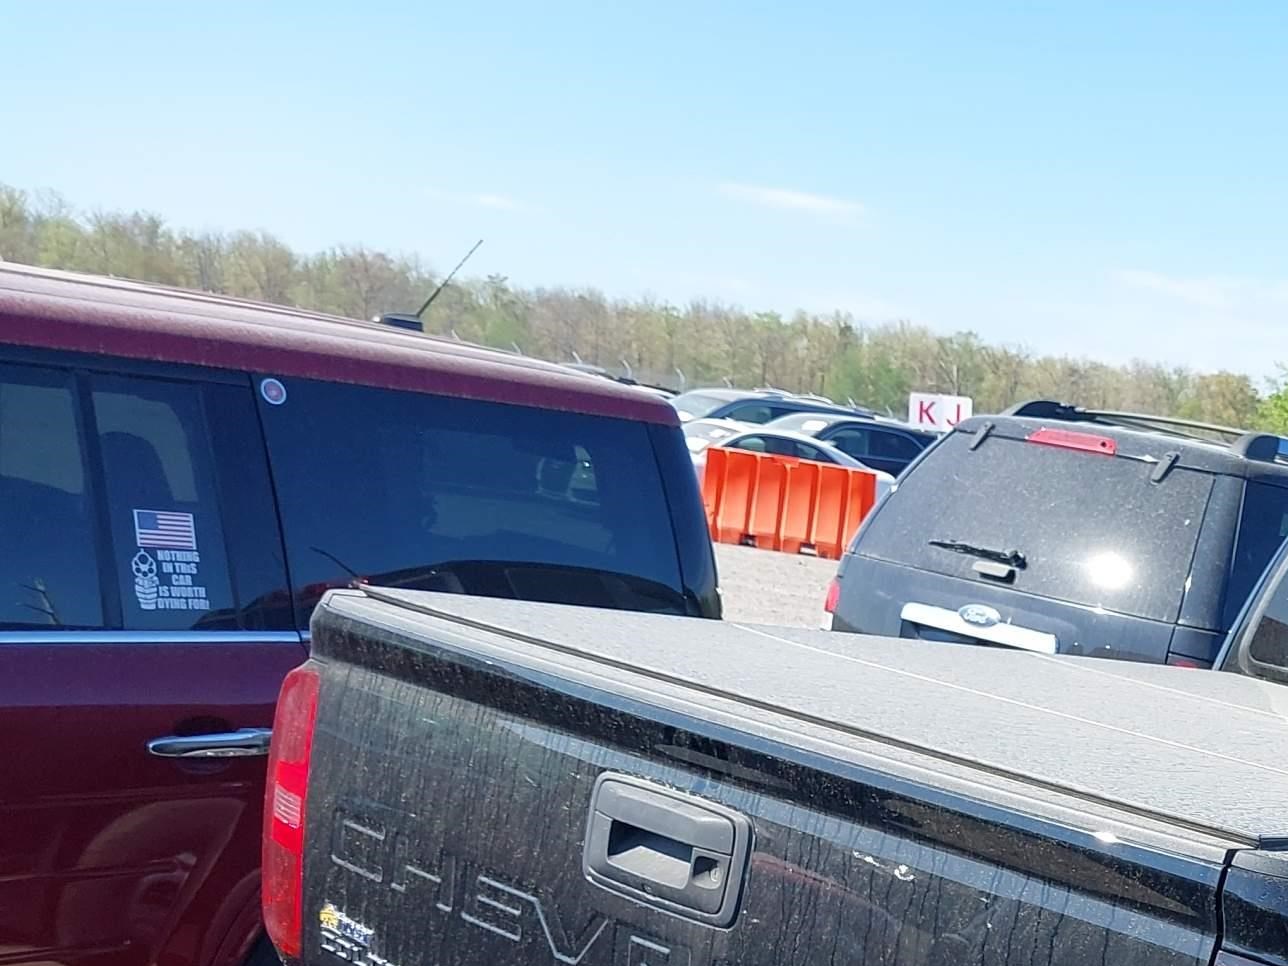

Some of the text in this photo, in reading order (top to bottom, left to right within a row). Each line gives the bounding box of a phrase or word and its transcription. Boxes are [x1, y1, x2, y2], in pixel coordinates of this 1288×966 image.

[919, 400, 961, 426] K J
[157, 549, 200, 562] NOTHING
[162, 562, 173, 573] IN
[171, 574, 193, 586] CAR
[158, 586, 206, 598] IS WORTH
[157, 597, 187, 609] DYING
